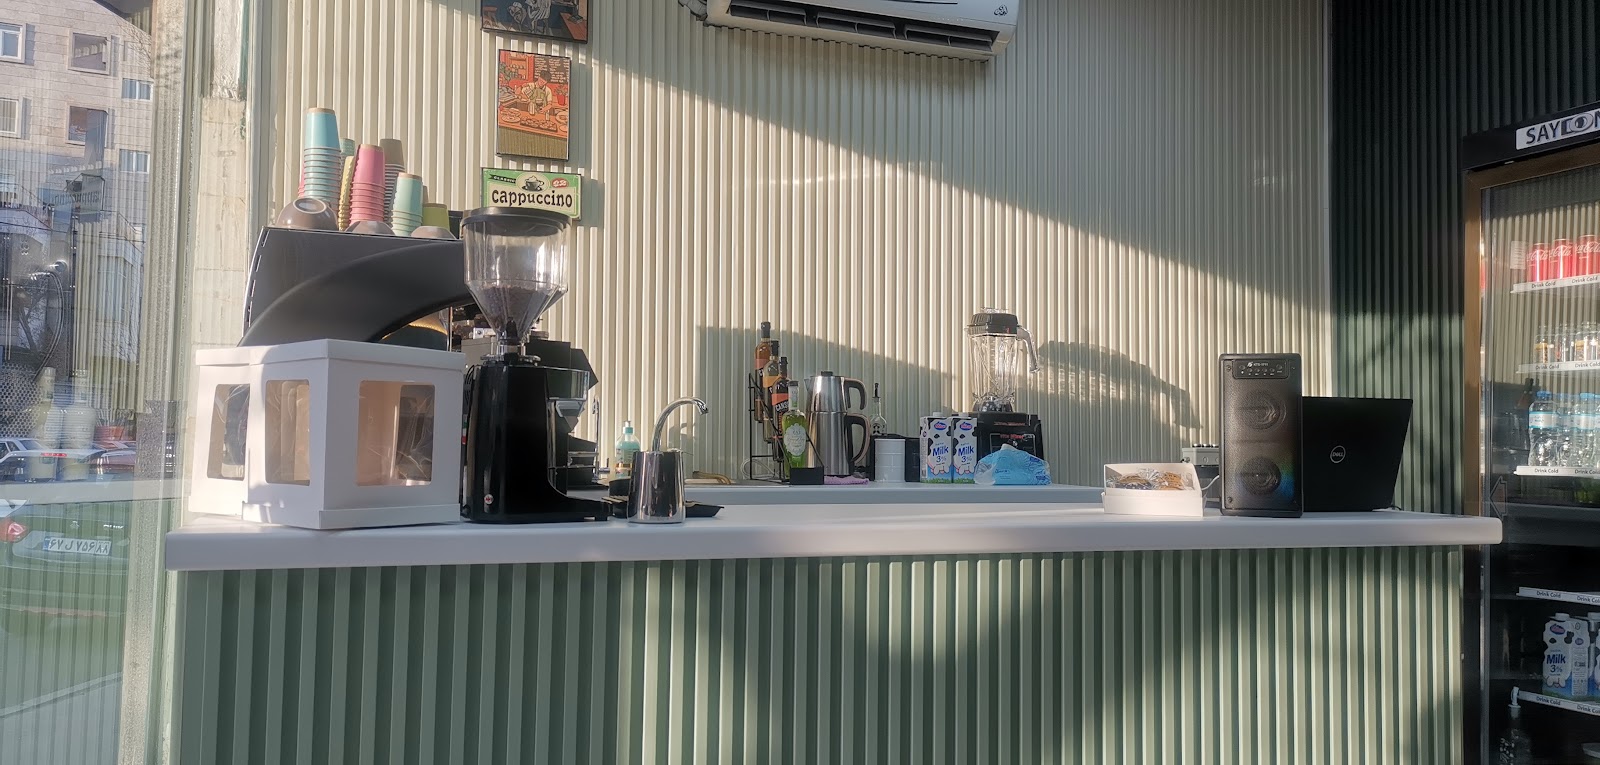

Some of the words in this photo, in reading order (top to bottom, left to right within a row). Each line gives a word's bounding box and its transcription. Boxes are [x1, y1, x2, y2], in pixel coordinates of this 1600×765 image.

[492, 189, 573, 207] cappuccino
[932, 445, 949, 457] Milk
[958, 445, 974, 457] Milk
[936, 455, 947, 463] 3%
[961, 455, 972, 463] 3%
[1546, 654, 1566, 665] Milk
[1550, 664, 1563, 673] 3%
